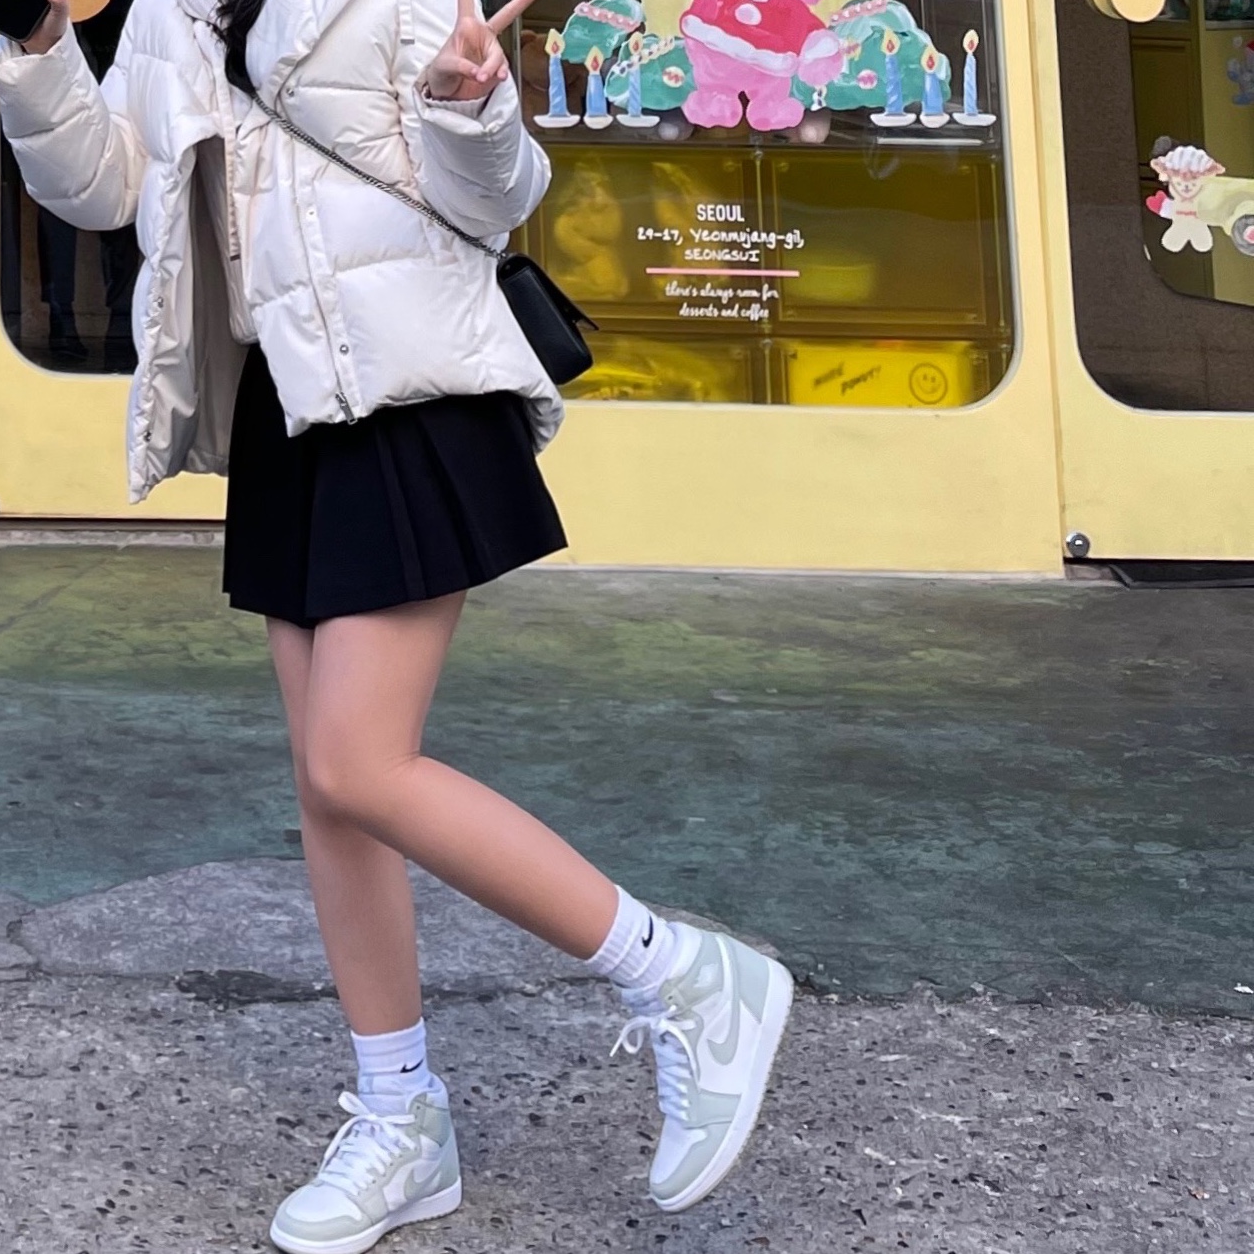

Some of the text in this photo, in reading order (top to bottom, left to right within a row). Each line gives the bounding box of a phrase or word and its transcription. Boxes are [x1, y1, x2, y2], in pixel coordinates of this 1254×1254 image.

[697, 204, 744, 222] SEOUL
[679, 302, 770, 321] desserts and coffee
